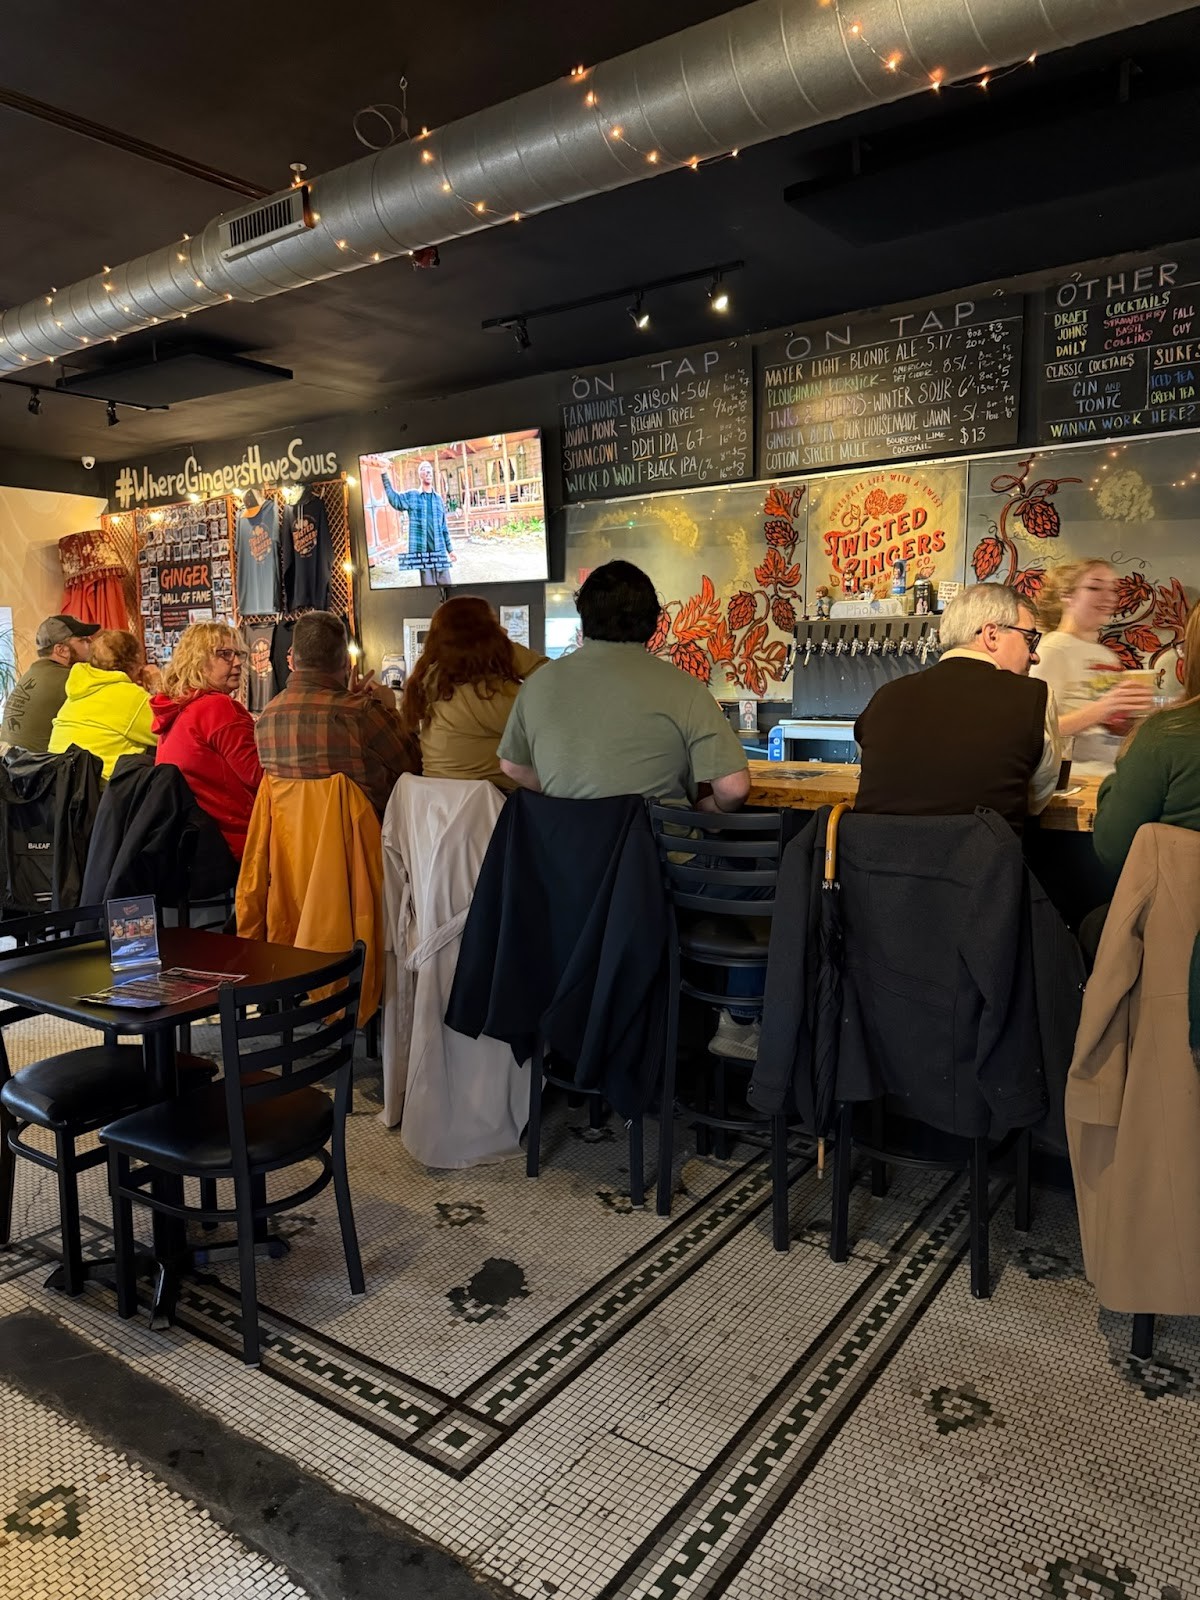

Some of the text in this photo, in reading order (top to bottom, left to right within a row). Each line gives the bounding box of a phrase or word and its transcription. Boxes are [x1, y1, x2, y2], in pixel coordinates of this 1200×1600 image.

[1057, 263, 1178, 307] OTHER
[1105, 291, 1171, 317] COCKTAILS
[1172, 305, 1195, 320] FALL
[786, 301, 975, 360] ON TAP
[1054, 309, 1089, 327] DRAFT
[1115, 324, 1143, 337] BASIL
[1055, 339, 1087, 357] DAILY
[1104, 329, 1153, 350] COLLINS
[572, 351, 719, 399] ON TAP
[765, 363, 803, 388] MAYER
[811, 356, 842, 378] LIGHT
[850, 346, 891, 370] BLONDE
[895, 338, 918, 362] ALE
[892, 360, 933, 374] AMERICAN
[1046, 353, 1135, 379] CLASSIC COCKTAILS
[1072, 380, 1121, 397] GIN AND
[1151, 369, 1195, 389] ICED TEA
[563, 397, 626, 428] FARMHOUSE
[634, 383, 679, 413] SAISON
[767, 380, 823, 408] PLOUGHMAN
[873, 386, 914, 412] WINTER
[918, 376, 952, 404] SOUR
[1075, 392, 1121, 413] TONIC
[1150, 386, 1195, 404] GREEN TEA
[563, 425, 589, 449] JOVIAL
[592, 419, 618, 442] MONK
[631, 411, 663, 435] BELGIAN
[667, 406, 695, 425] TRIPEL
[843, 420, 861, 441] OUR
[864, 411, 919, 437] HOUSEMADE
[923, 407, 951, 428] JAWN
[1050, 404, 1196, 438] WANNA WORK HERE?
[632, 436, 655, 459] DDH
[660, 432, 678, 454] IPA
[959, 426, 986, 446] $13
[802, 444, 834, 465] STREET
[565, 468, 610, 494] WICKED
[612, 461, 644, 486] WOLF
[648, 458, 677, 480] BLACK
[681, 456, 697, 475] IPA
[890, 474, 911, 484] WITH
[922, 485, 944, 508] TWIST
[824, 507, 927, 573] TWISTED
[161, 565, 211, 590] GINGER
[161, 590, 211, 605] WALL OF FAME
